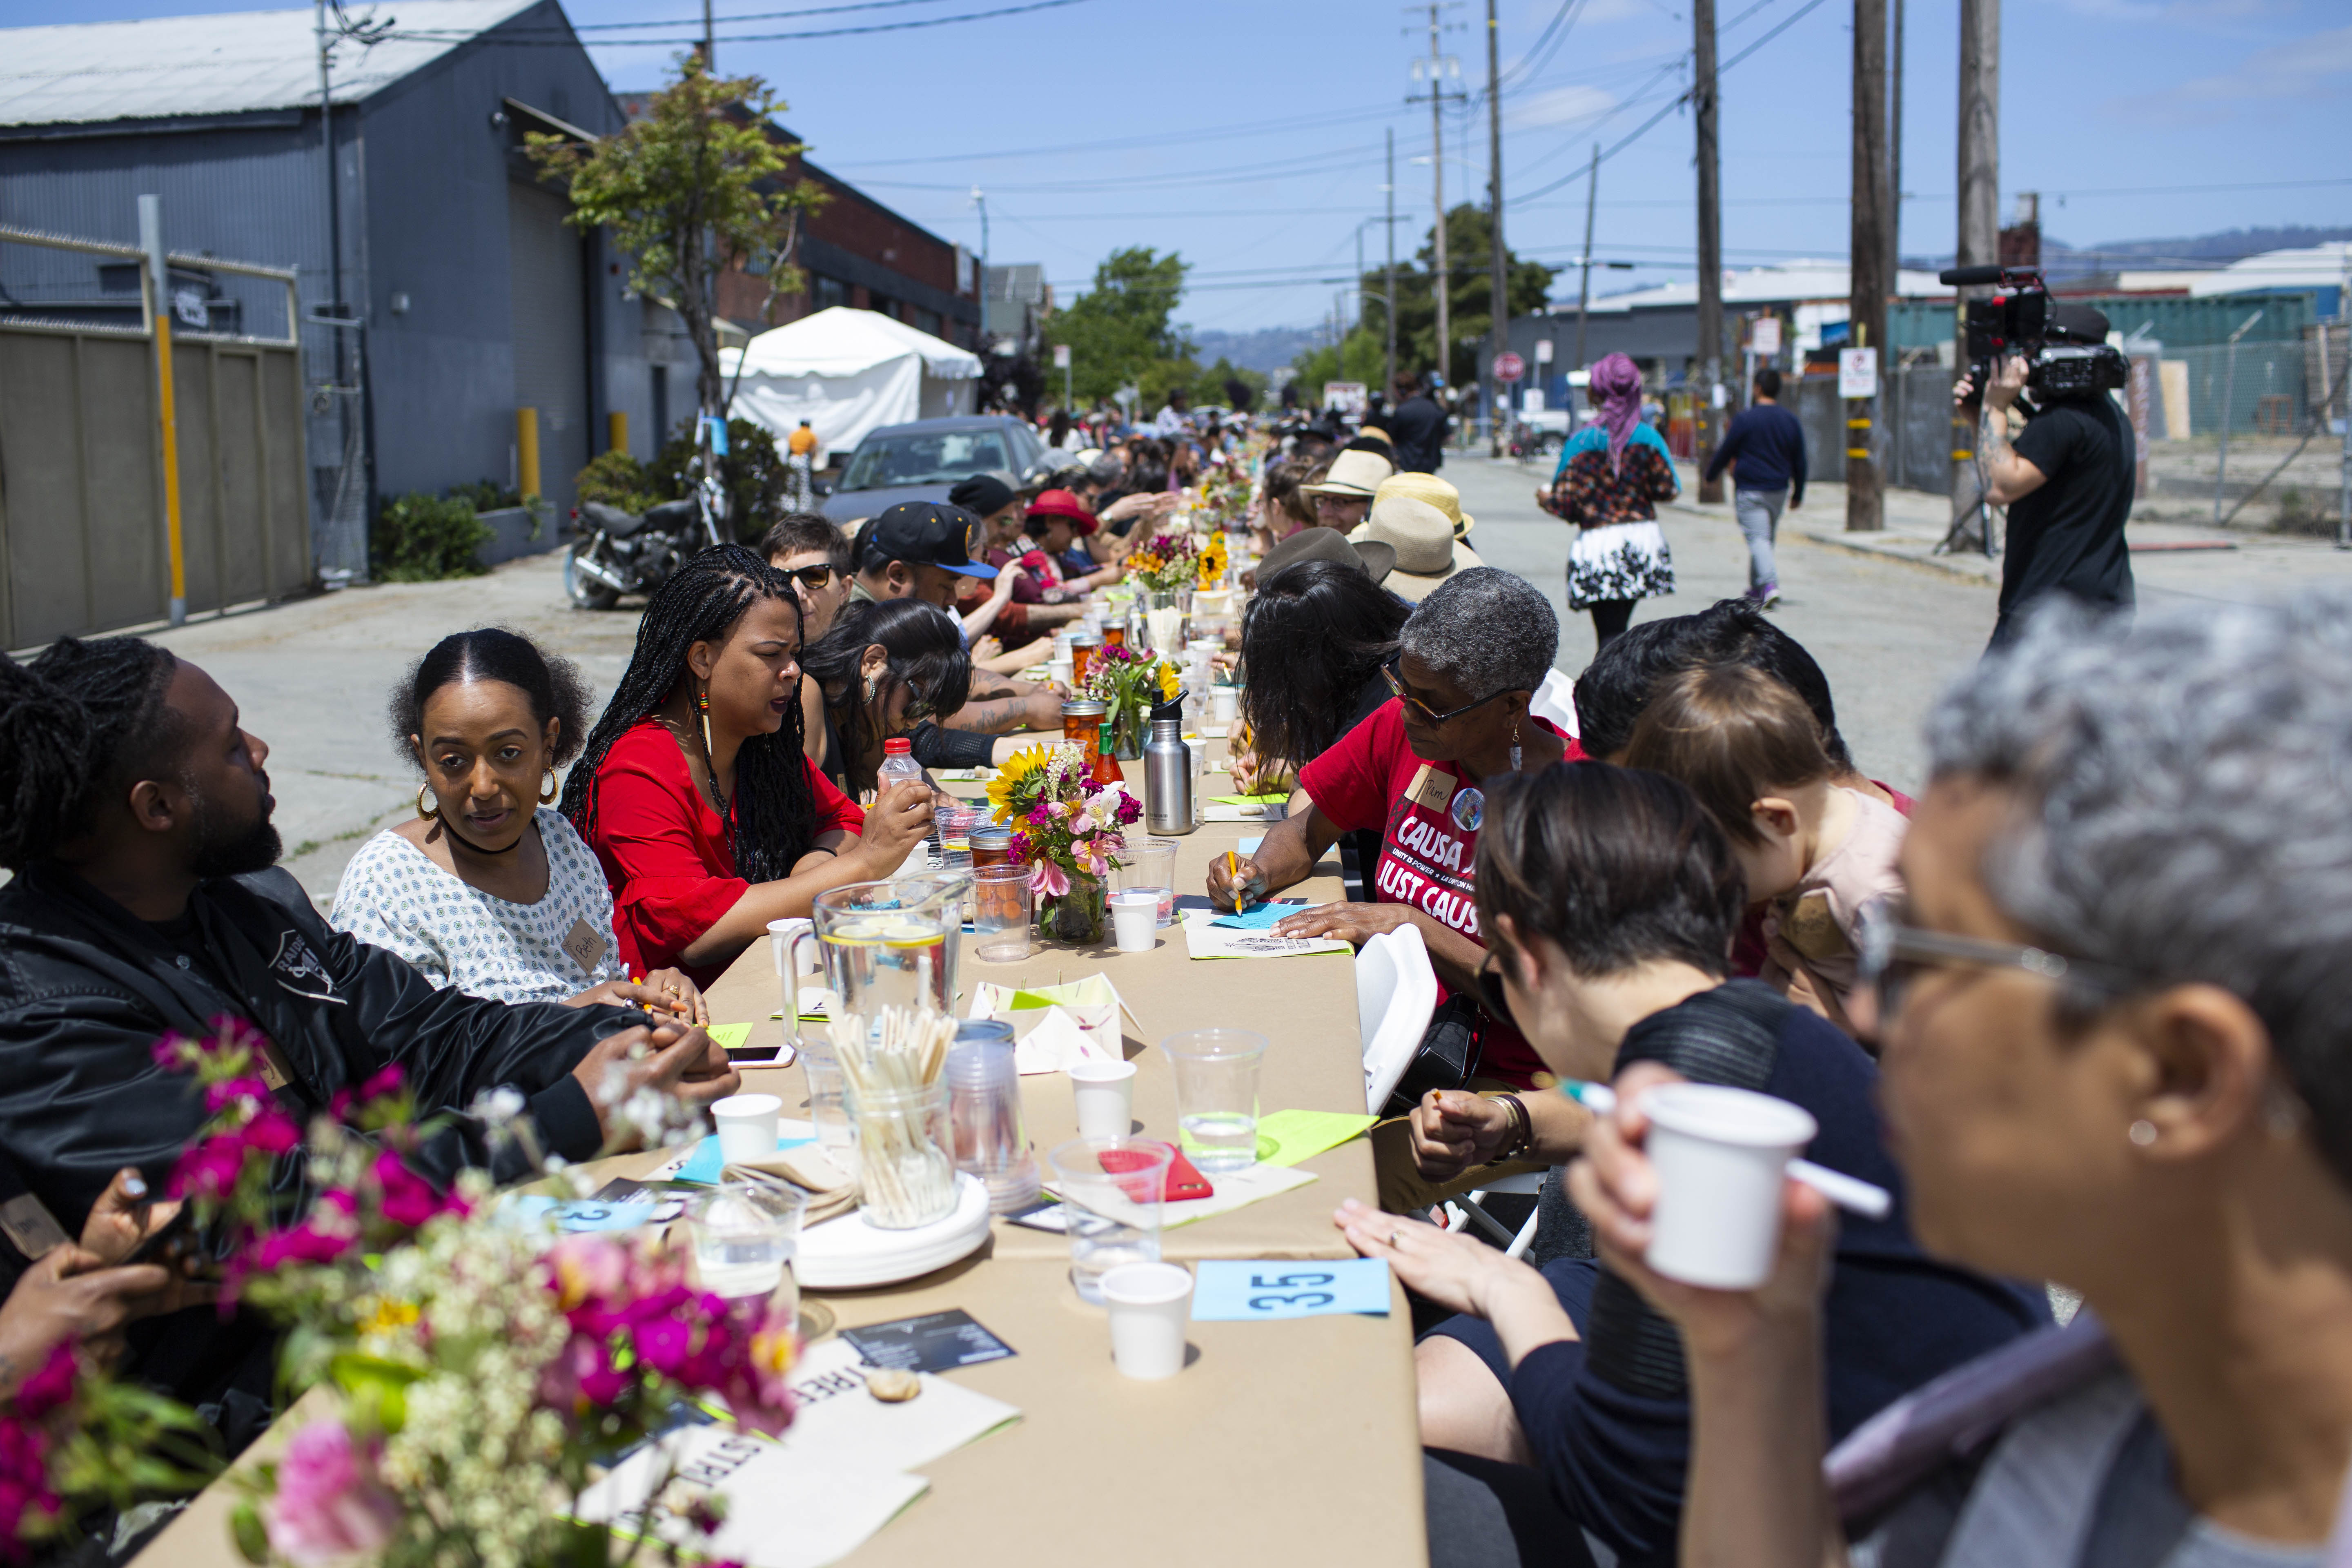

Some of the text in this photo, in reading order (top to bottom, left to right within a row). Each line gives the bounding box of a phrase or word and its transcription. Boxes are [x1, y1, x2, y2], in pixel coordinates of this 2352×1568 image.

[1425, 779, 1449, 800] Pam
[1398, 816, 1464, 872] CAUSA
[1392, 847, 1409, 861] UNITY
[1412, 859, 1434, 875] POWER
[1448, 878, 1466, 889] UNION
[1377, 859, 1425, 904] JUST
[1422, 886, 1483, 938] CAUS
[576, 936, 597, 959] Beth
[1250, 1273, 1334, 1310] 35
